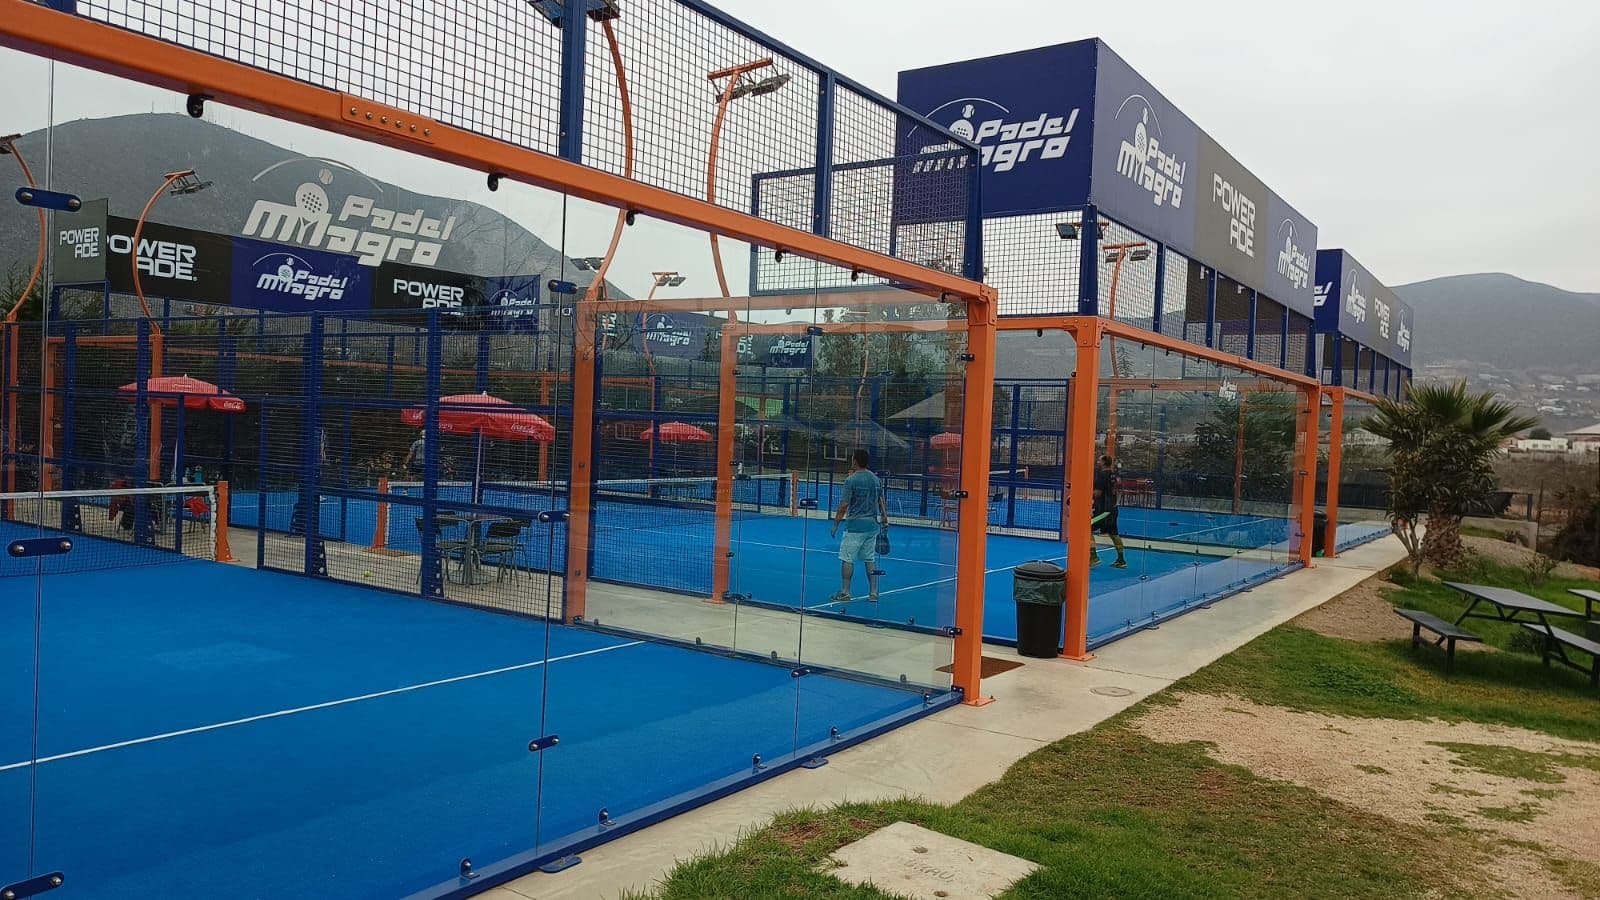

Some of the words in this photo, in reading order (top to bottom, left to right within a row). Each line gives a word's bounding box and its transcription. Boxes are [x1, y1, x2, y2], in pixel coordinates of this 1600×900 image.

[975, 108, 1080, 144] Padel
[1147, 137, 1186, 185] Padel
[338, 195, 456, 240] Padel
[1213, 173, 1256, 231] POWER
[60, 227, 100, 246] POWER
[74, 242, 100, 258] ADE
[107, 234, 197, 263] OWER
[1230, 218, 1255, 258] ADE
[293, 270, 348, 288] Padel
[393, 279, 464, 302] POWER
